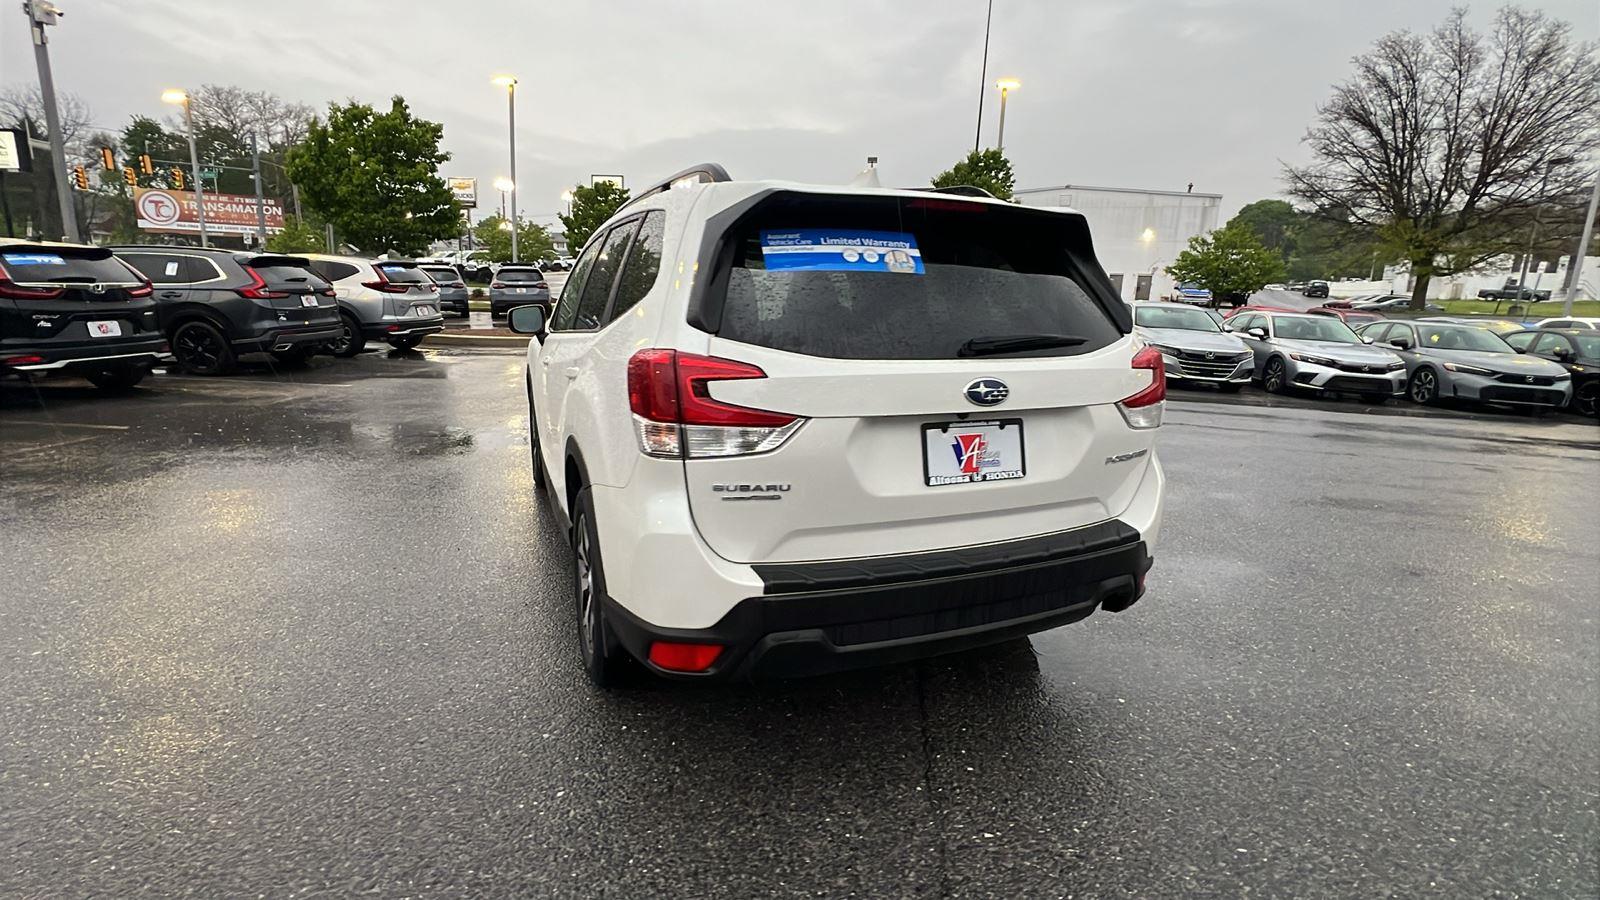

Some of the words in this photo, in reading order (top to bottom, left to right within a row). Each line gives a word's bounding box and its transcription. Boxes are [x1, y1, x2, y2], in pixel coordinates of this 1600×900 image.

[181, 200, 282, 216] TRANS4MATON
[820, 236, 861, 246] Limited
[862, 237, 910, 249] Warranty
[986, 469, 1024, 481] HONDA
[712, 483, 791, 492] SUBARU
